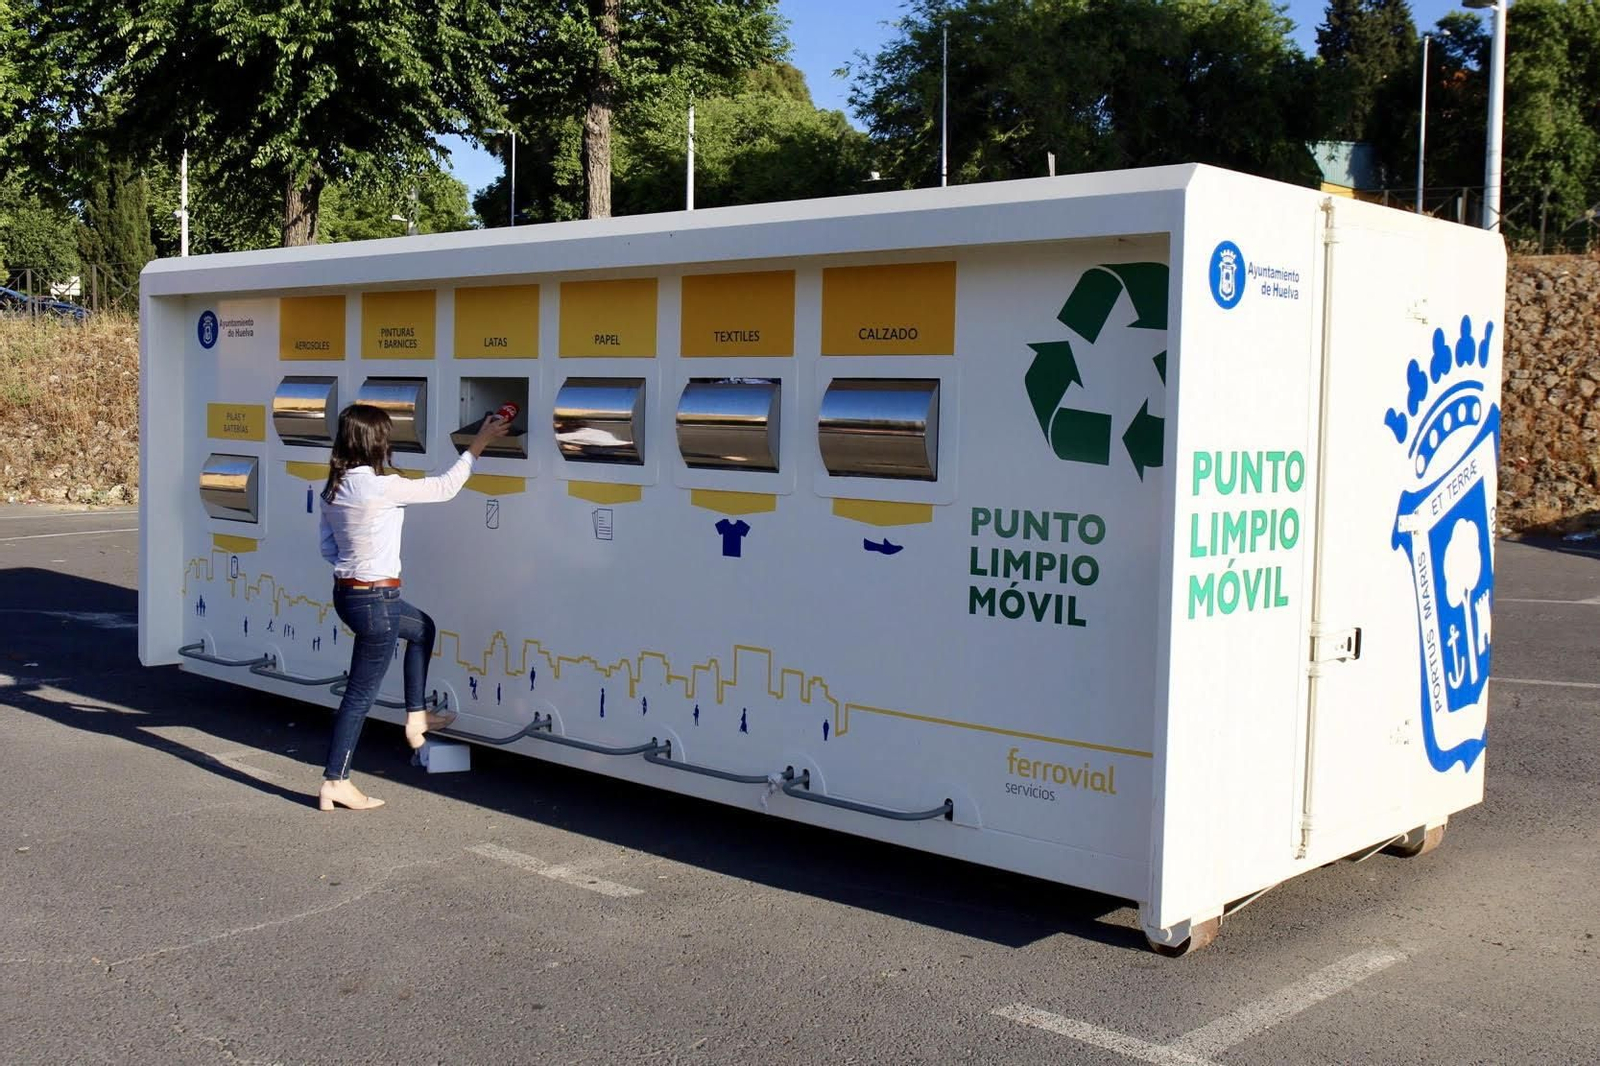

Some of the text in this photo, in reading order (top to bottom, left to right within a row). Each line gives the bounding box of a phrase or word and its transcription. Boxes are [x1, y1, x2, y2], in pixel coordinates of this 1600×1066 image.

[1248, 261, 1300, 283] Ayuntamiento
[1261, 281, 1299, 300] de Huelva
[219, 318, 254, 330] Ayuntamiento
[227, 328, 254, 338] de Huelva
[380, 327, 415, 337] PINTURAS
[484, 337, 508, 347] LATAS
[594, 334, 621, 346] PAPEL
[714, 330, 760, 343] TEXTILES
[858, 328, 918, 340] CALZADO
[294, 341, 330, 351] AEROSOLES
[378, 339, 417, 349] Y BARNICES
[226, 412, 240, 421] PILAS
[1192, 450, 1305, 496] PUNTO
[1431, 492, 1443, 516] ET
[971, 507, 1106, 545] PUNTO
[1190, 507, 1299, 558] LIMPIO
[970, 546, 1099, 586] LIMPIO
[1188, 558, 1289, 620] MÓVIL
[969, 581, 1087, 627] MÓVIL
[1417, 551, 1442, 713] PORTUS MARIS
[1007, 747, 1117, 795] ferrovial
[1005, 782, 1056, 801] servicios
